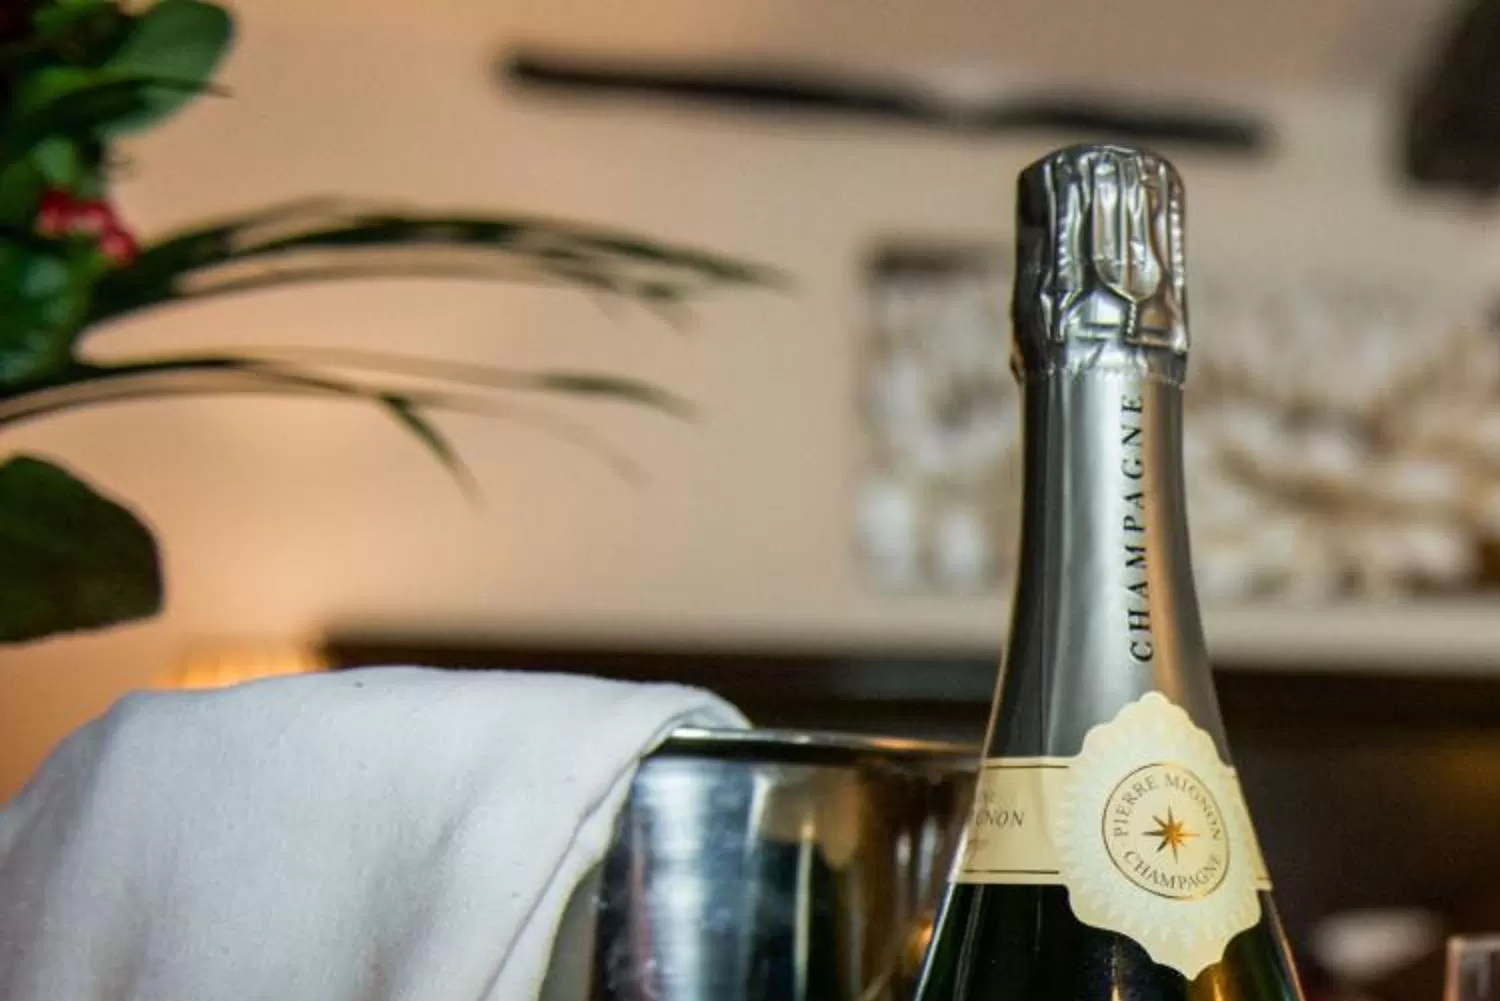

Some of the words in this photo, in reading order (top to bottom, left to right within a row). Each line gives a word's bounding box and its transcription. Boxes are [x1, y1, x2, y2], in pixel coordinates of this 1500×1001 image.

[1121, 395, 1155, 664] CHAMPAGNE
[1113, 775, 1158, 837] PIERRE
[1164, 772, 1221, 840] MIGNON
[1122, 851, 1222, 890] CHAMPAGNE
